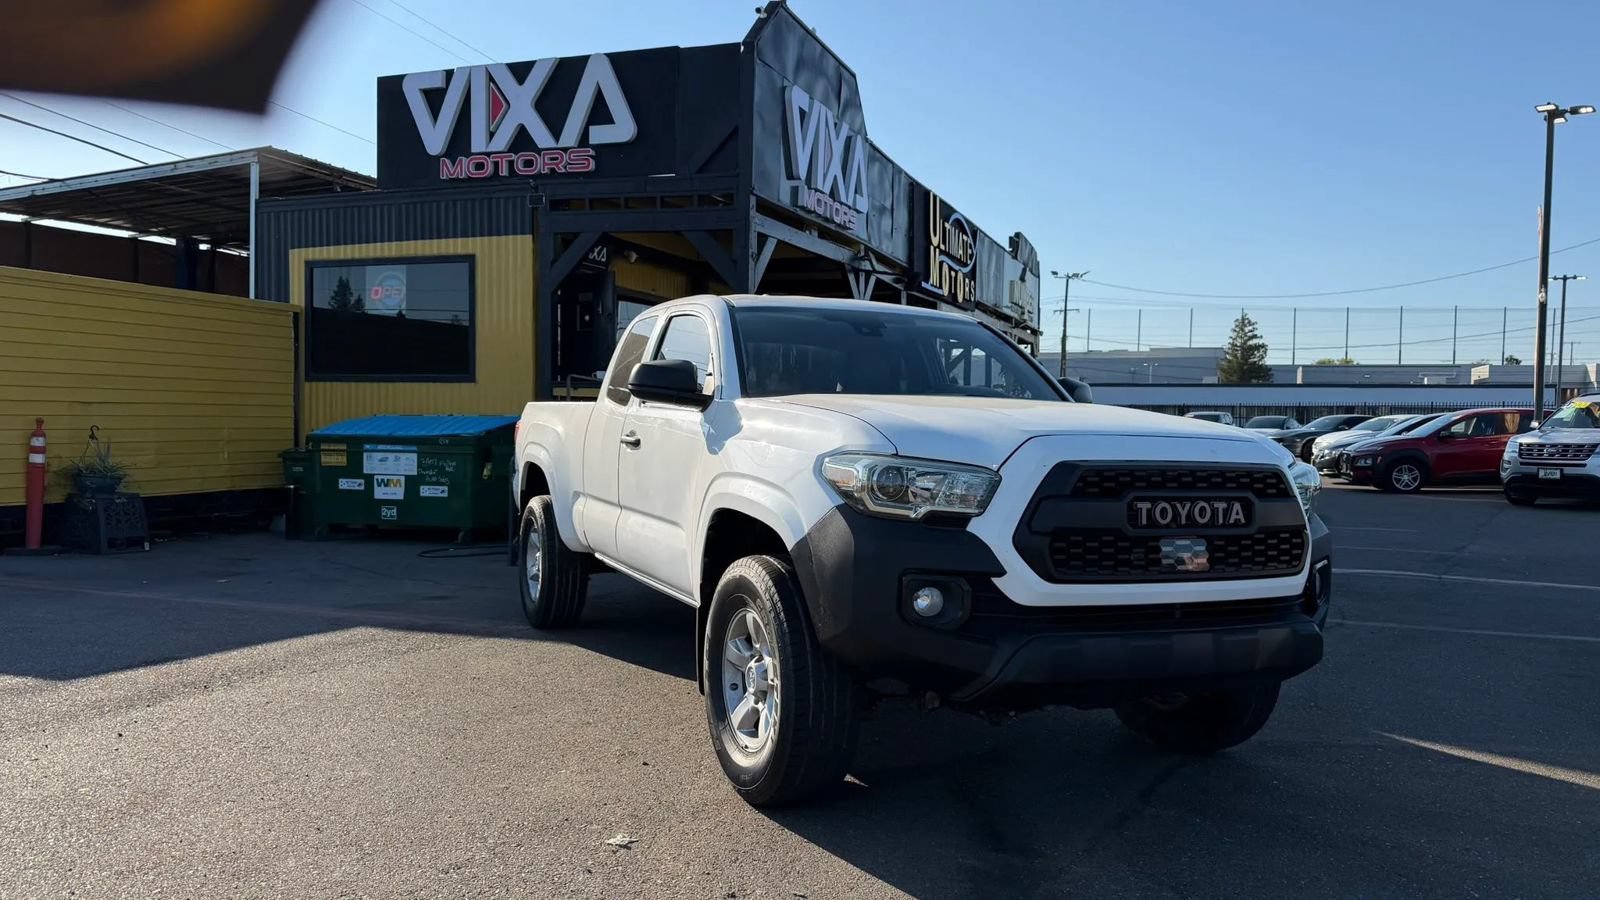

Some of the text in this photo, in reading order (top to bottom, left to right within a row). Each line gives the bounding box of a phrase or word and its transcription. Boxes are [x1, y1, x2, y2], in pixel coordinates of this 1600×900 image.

[402, 53, 637, 156] VIXA
[440, 149, 595, 180] MOTORS
[785, 85, 868, 214] VIXA
[802, 186, 858, 231] MOTORS
[930, 192, 973, 265] ULTIMATE
[929, 245, 976, 303] MOTORS
[376, 478, 401, 488] WM
[382, 508, 396, 518] 2yd
[1134, 500, 1245, 525] TOYOTA
